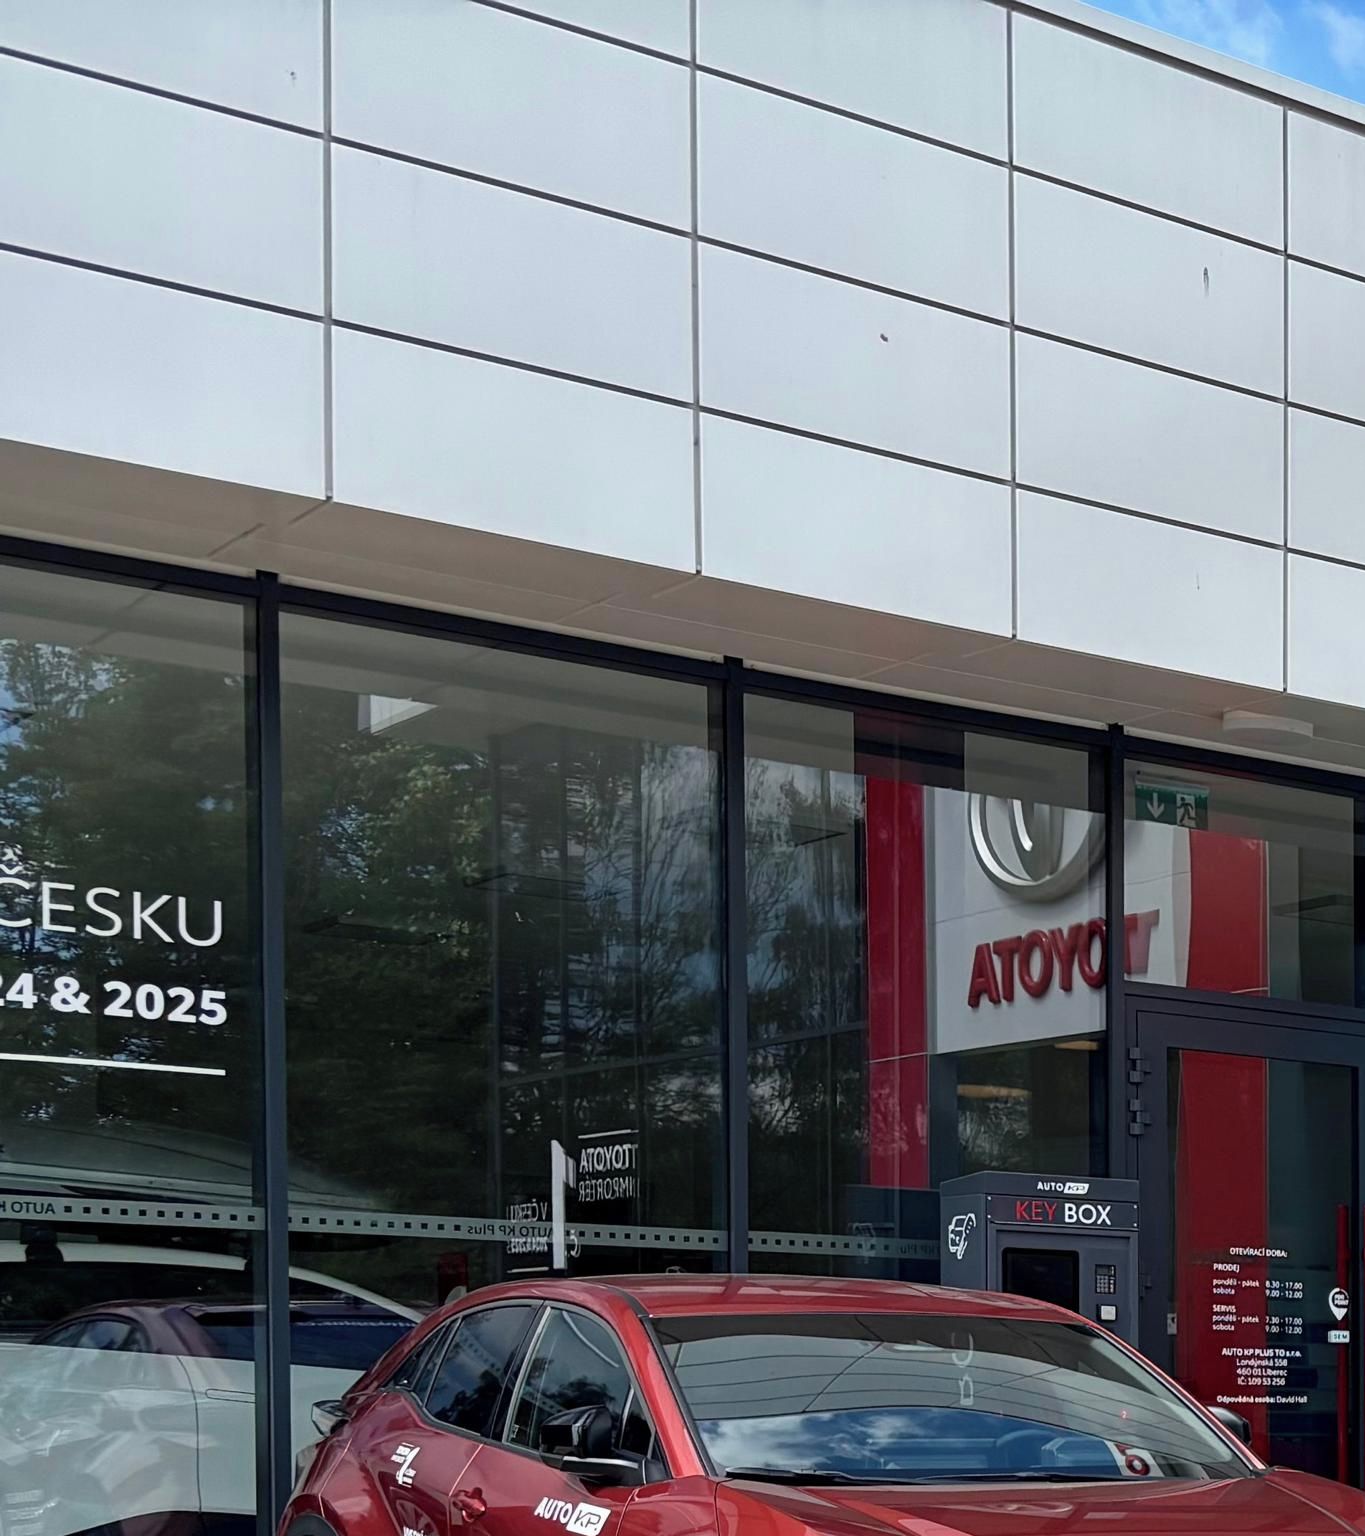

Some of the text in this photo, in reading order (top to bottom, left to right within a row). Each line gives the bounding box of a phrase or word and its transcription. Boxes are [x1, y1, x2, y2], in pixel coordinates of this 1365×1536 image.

[0, 864, 222, 947] ČESKU
[50, 976, 92, 1014] &
[103, 981, 227, 1026] 2025
[1037, 1181, 1064, 1191] AUTO
[1015, 1201, 1112, 1226] KEY BOX
[1229, 1247, 1288, 1258] OTEVÍRACÍ DOBA:
[1213, 1263, 1240, 1273] PRODEJ
[1212, 1304, 1237, 1313] SERVIS
[1221, 1348, 1243, 1356] AUTO
[1243, 1348, 1254, 1356] KP
[1255, 1348, 1274, 1357] PLUS
[1274, 1349, 1285, 1357] TO
[1252, 1368, 1262, 1376] 01
[1262, 1368, 1288, 1377] Liberec
[534, 1496, 573, 1524] AUTO
